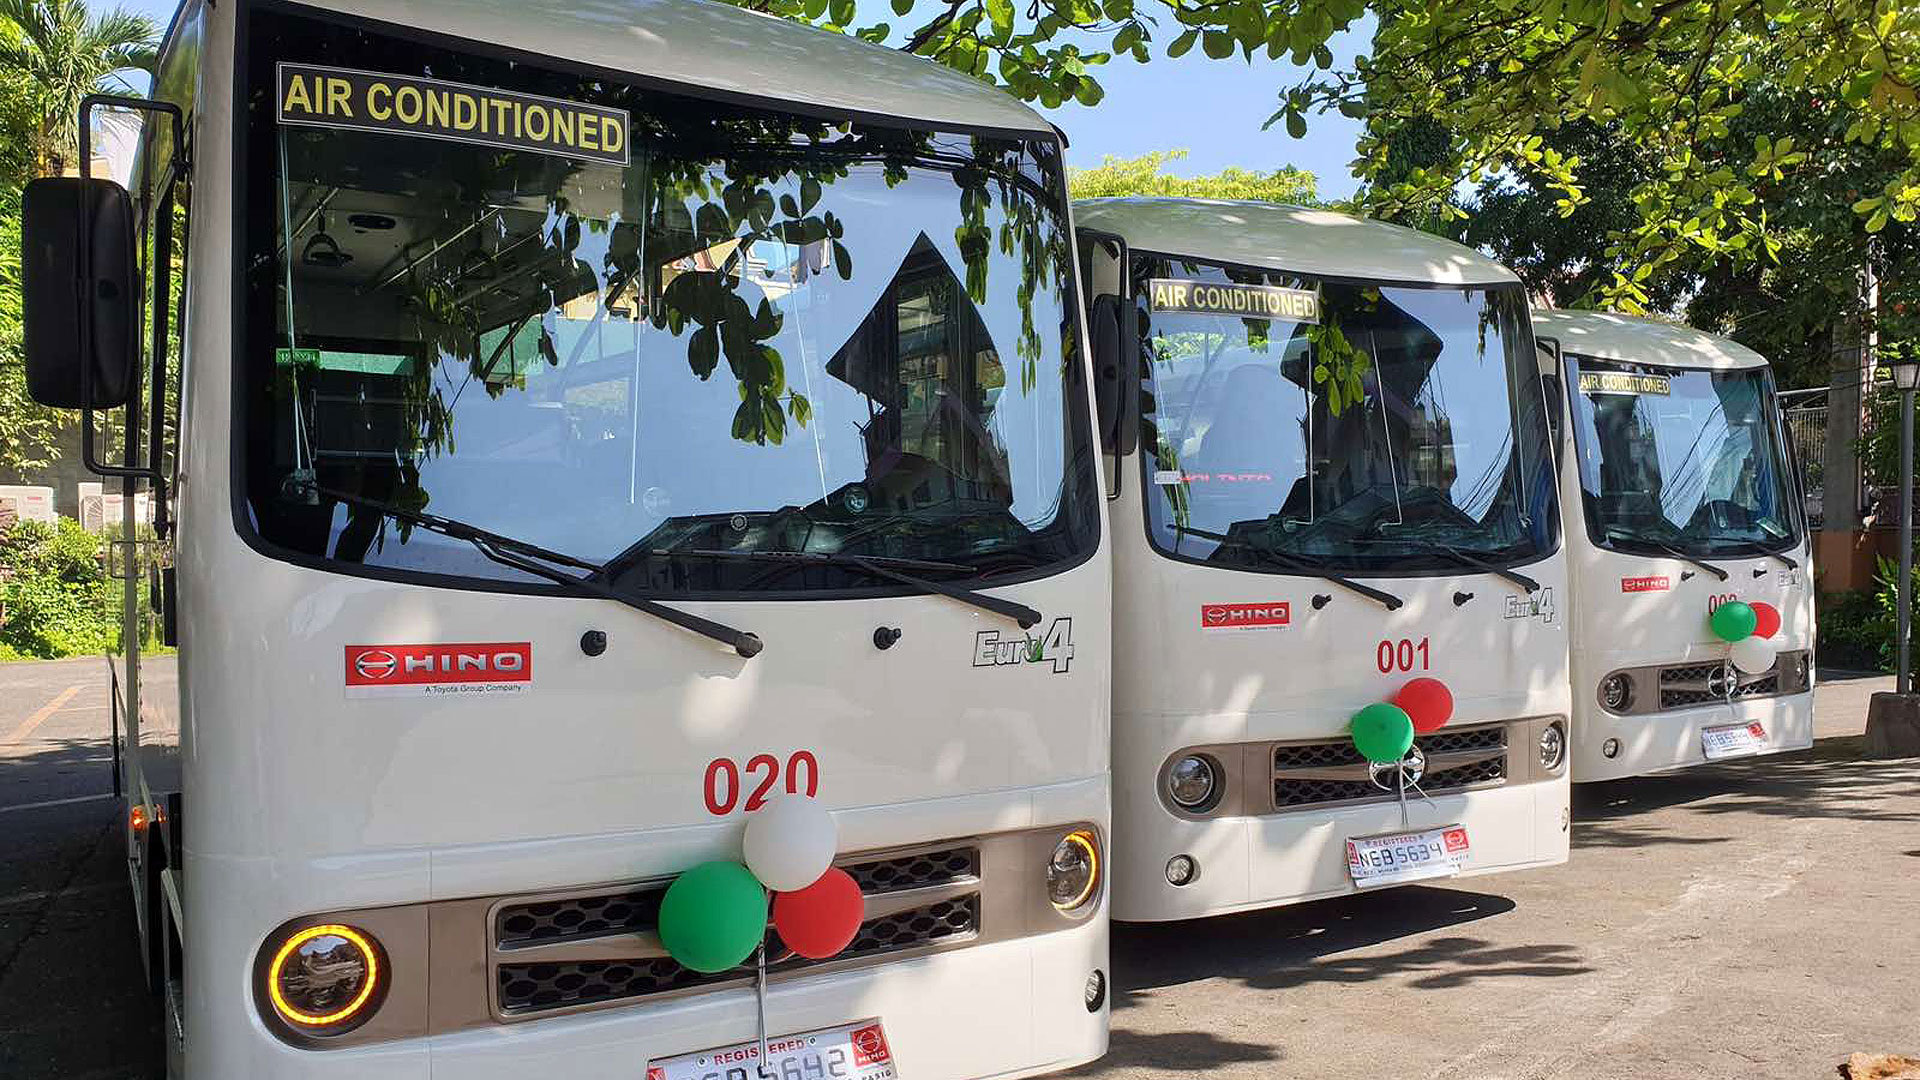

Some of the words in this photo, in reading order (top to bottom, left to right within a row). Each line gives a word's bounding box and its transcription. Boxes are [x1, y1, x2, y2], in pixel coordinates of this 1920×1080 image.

[283, 74, 354, 118] AIR
[366, 82, 625, 153] CONDITIONED
[1155, 285, 1188, 308] AIR
[1193, 286, 1316, 317] CONDITIONED
[1580, 374, 1600, 390] AIR
[1601, 374, 1670, 394] CONDITIONED
[1229, 607, 1286, 621] HINO
[972, 617, 1074, 674] Euro4
[1375, 637, 1430, 673] 001
[404, 652, 523, 673] HINO
[433, 684, 458, 695] Toyota
[461, 684, 485, 693] Group
[486, 682, 521, 693] Company
[703, 750, 819, 815] 020
[714, 1039, 805, 1066] REGISERED
[858, 1051, 886, 1063] HINO
